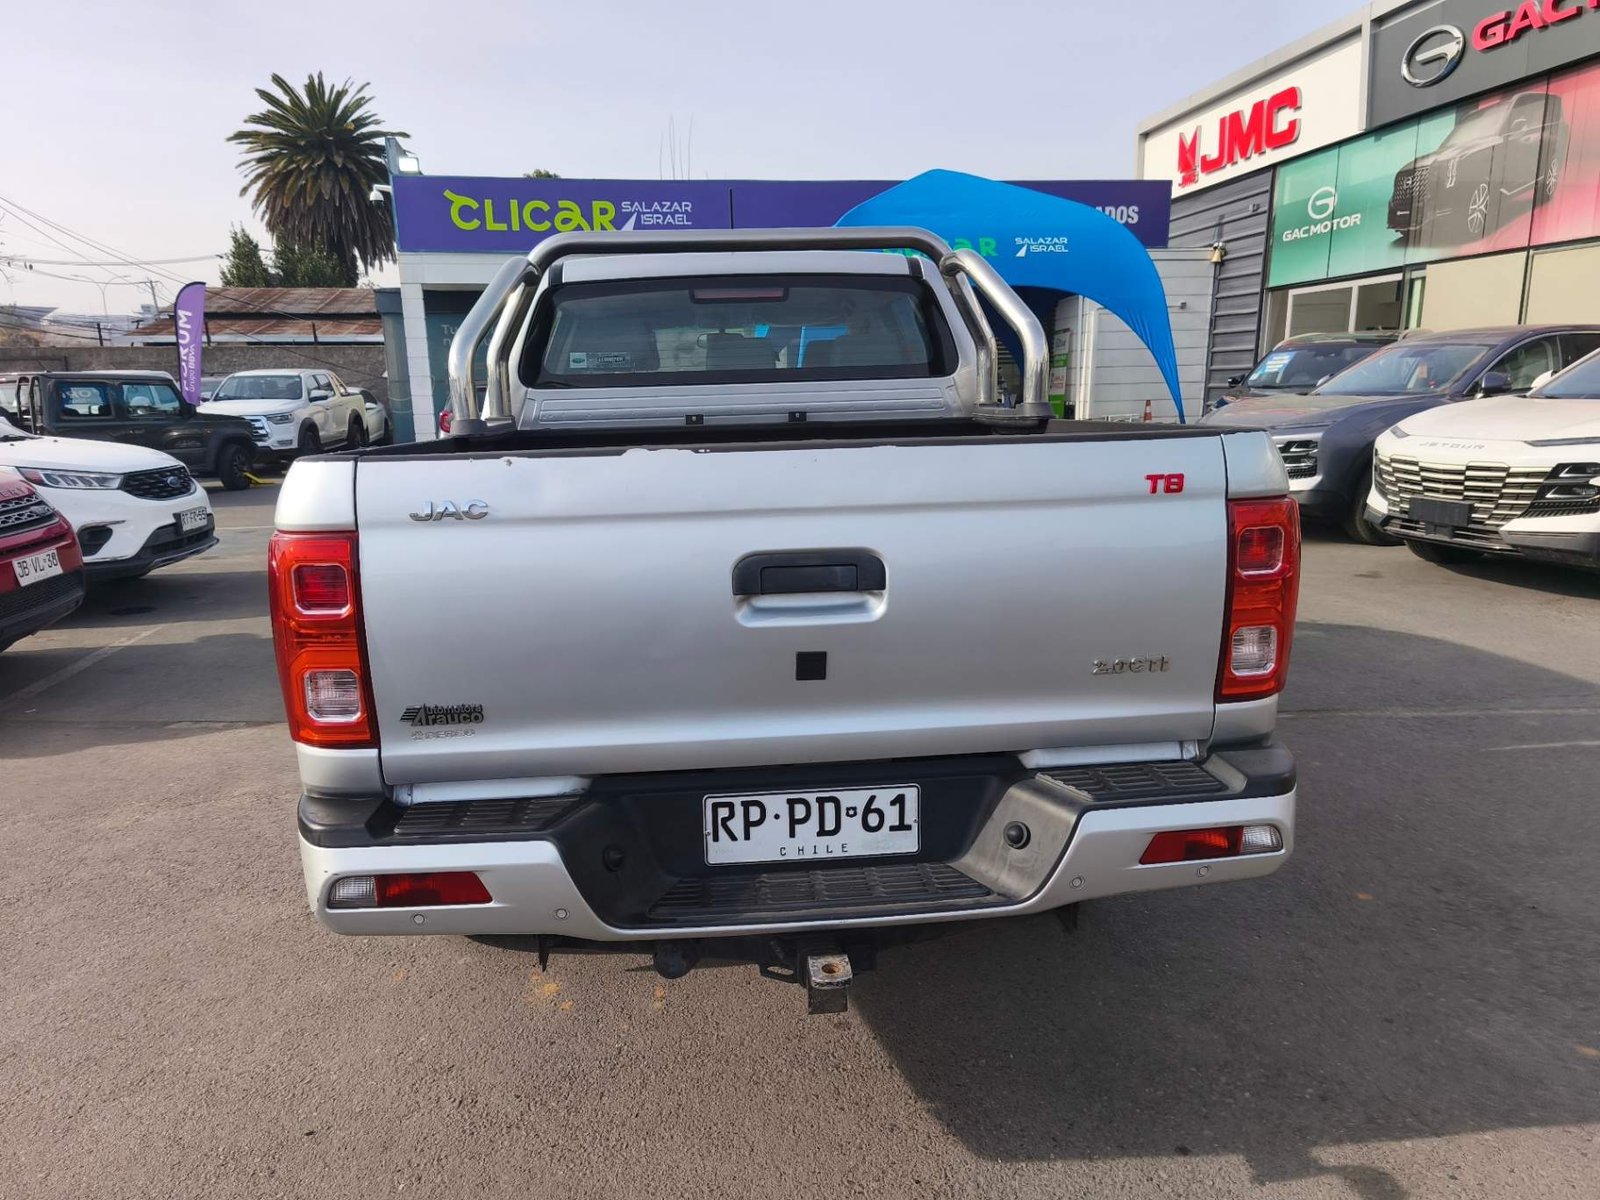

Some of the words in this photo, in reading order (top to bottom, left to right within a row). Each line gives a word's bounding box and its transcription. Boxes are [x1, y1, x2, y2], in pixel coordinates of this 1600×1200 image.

[1201, 86, 1301, 174] JMC
[621, 201, 692, 213] SALAZAR
[1096, 205, 1139, 224] DOS
[640, 214, 692, 225] ISRAEL
[1015, 237, 1068, 245] SALAZAR
[1029, 244, 1069, 253] ISRAEL
[1145, 473, 1184, 494] T8
[409, 499, 488, 521] JAC
[411, 706, 484, 726] Arauco
[779, 843, 848, 857] CHILE
